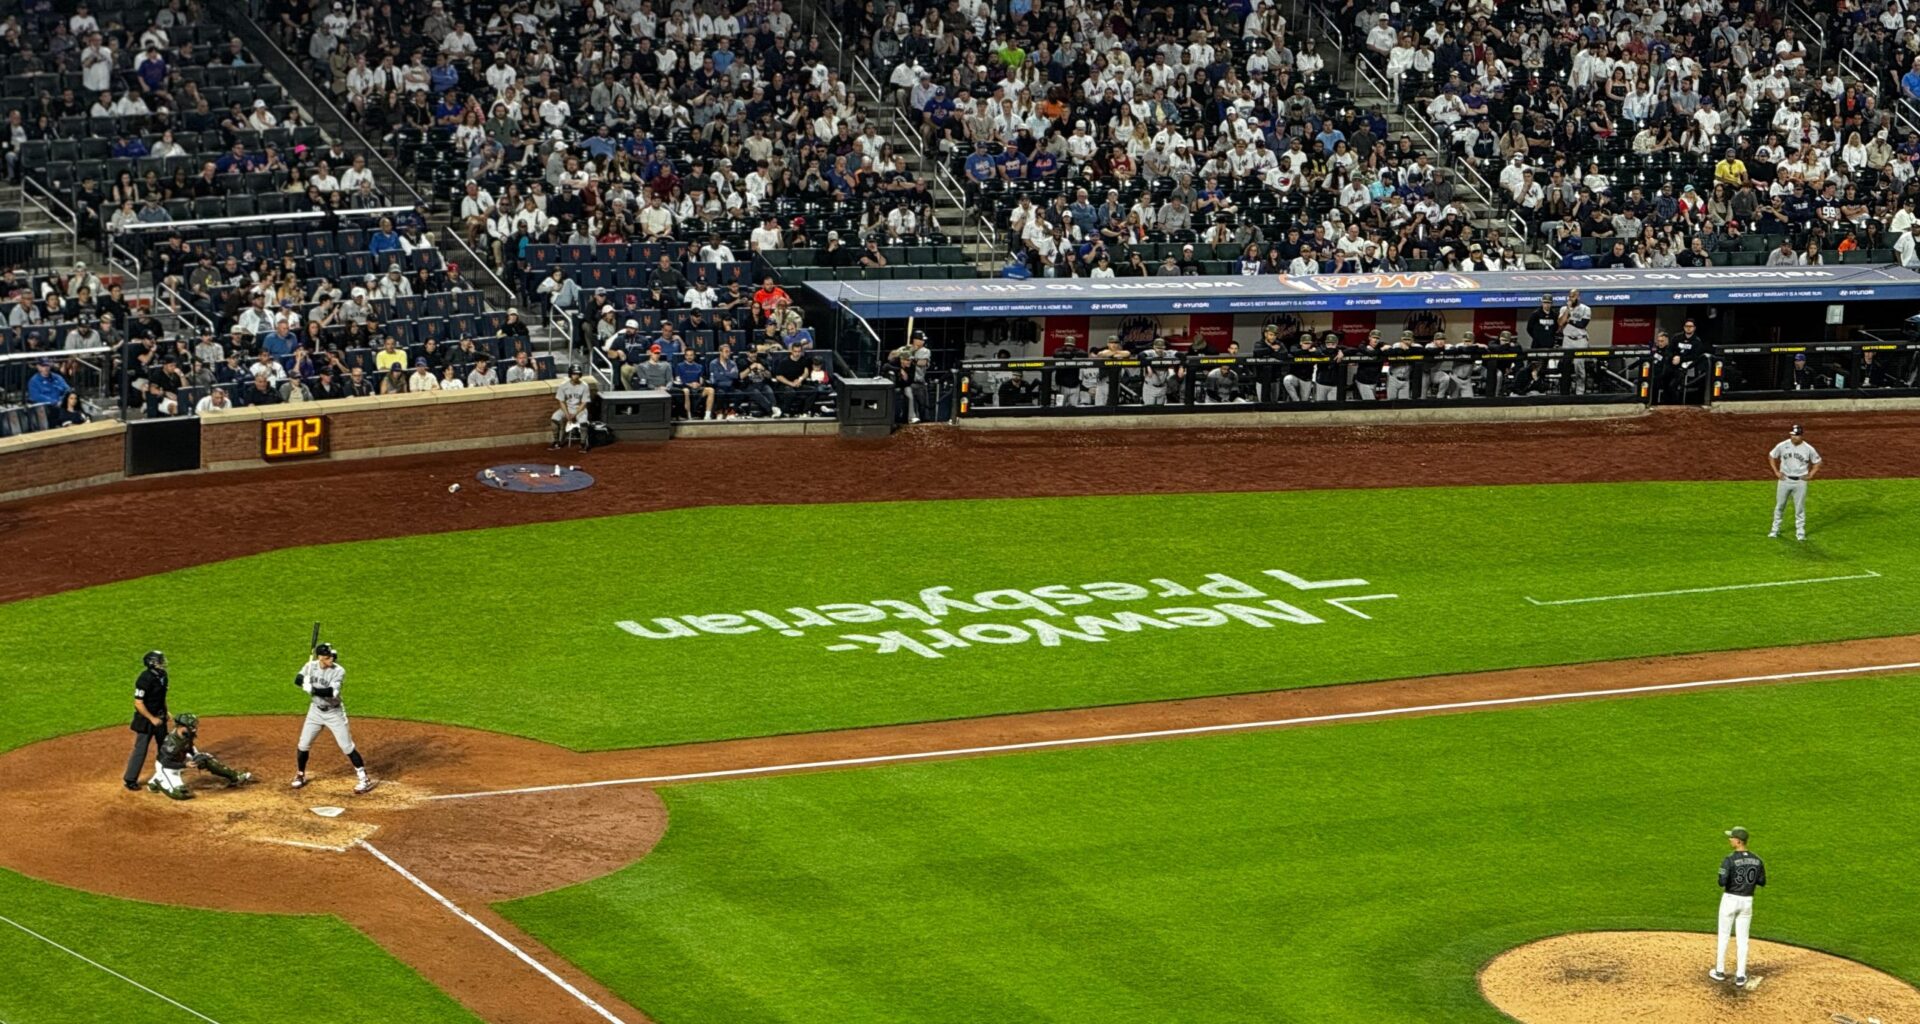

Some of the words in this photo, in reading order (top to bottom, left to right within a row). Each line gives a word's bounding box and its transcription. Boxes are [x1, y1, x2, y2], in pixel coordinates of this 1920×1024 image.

[1822, 206, 1836, 218] 99
[1686, 271, 1835, 279] welcome
[1045, 283, 1085, 291] to
[1090, 281, 1244, 290] welcome
[1311, 273, 1434, 291] Mets
[980, 284, 1037, 292] citi
[614, 572, 1268, 639] Presbyterian
[1735, 867, 1758, 884] 30
